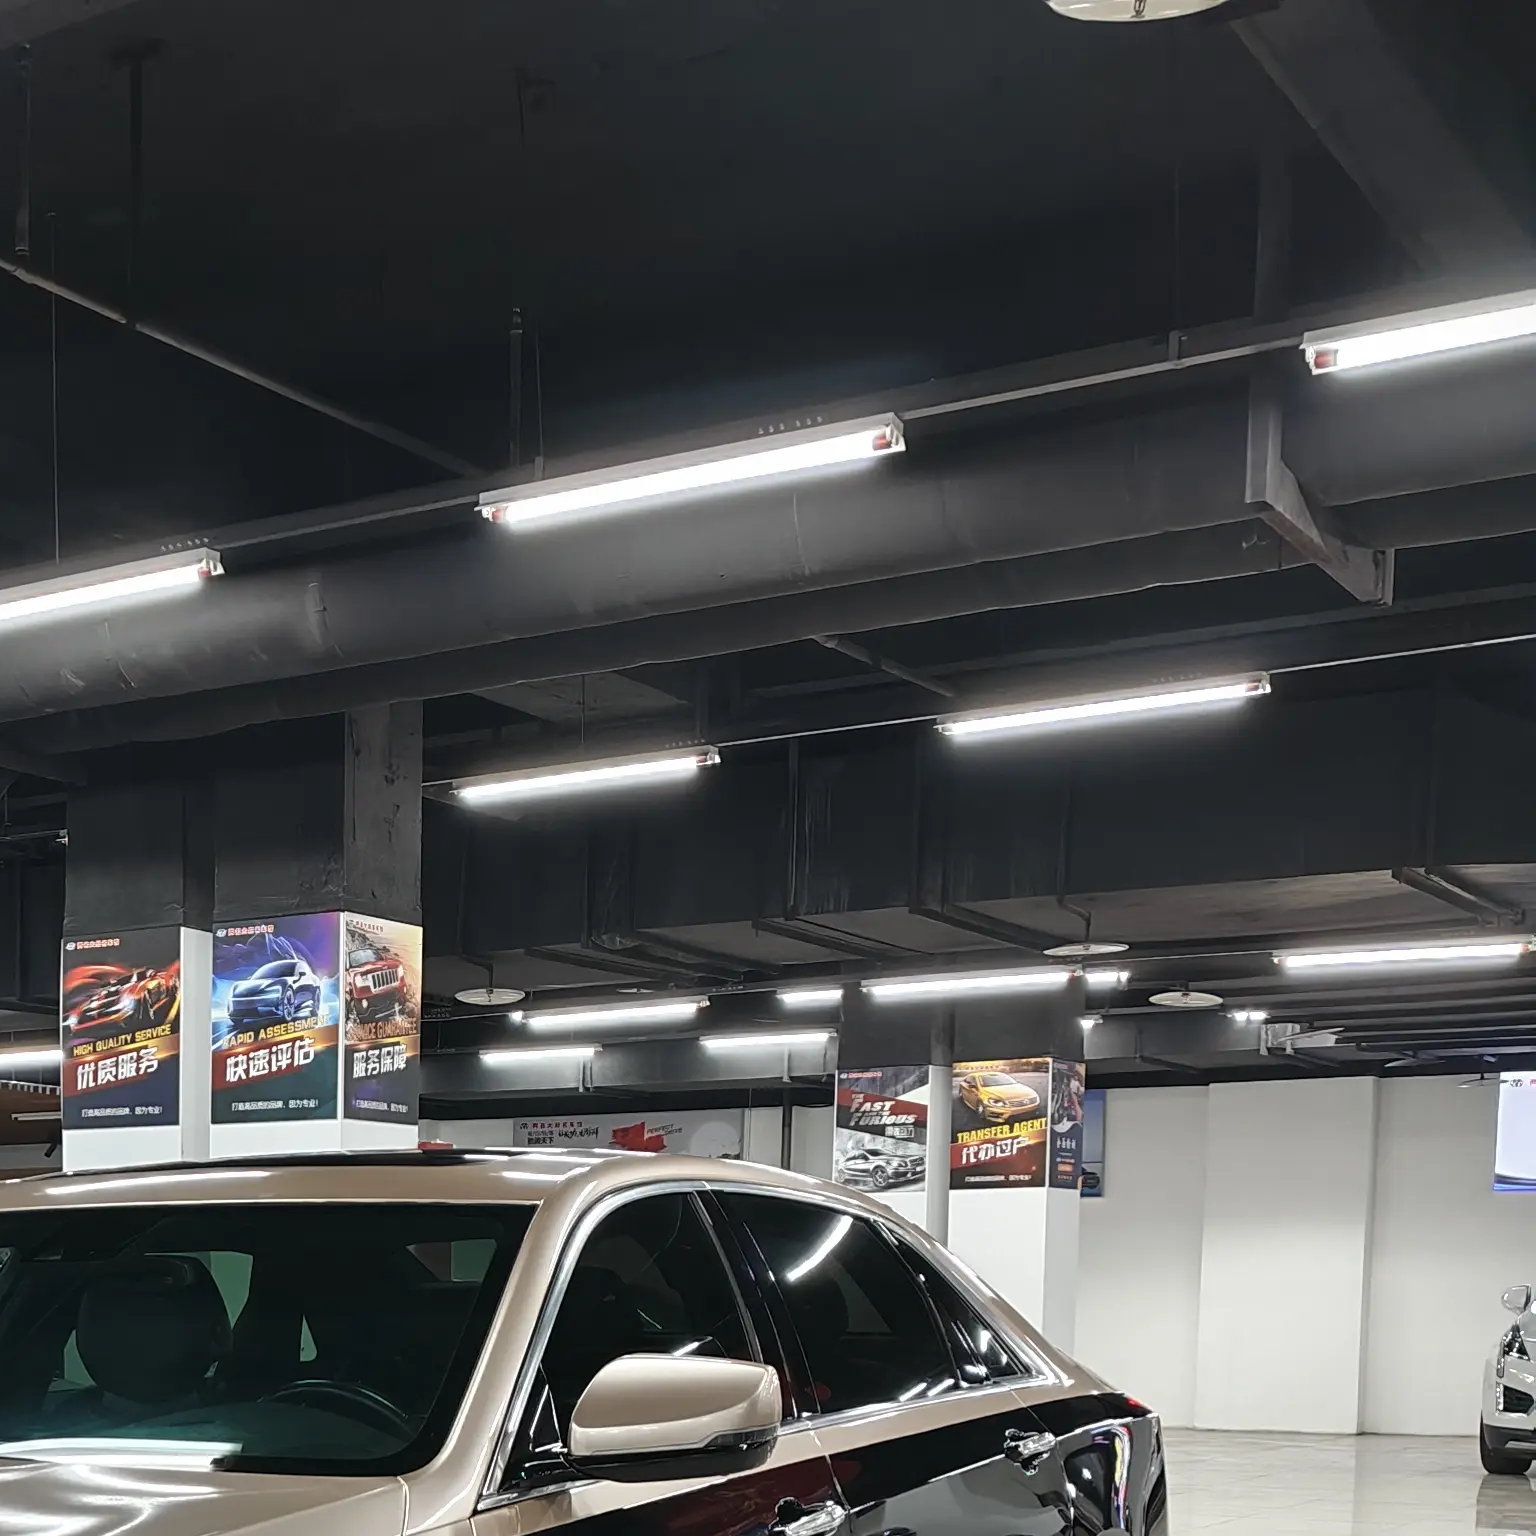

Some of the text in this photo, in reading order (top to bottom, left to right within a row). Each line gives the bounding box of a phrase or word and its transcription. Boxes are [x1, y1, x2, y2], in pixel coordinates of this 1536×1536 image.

[73, 1023, 172, 1057] HIGH QUALITY SERVICE
[222, 1014, 331, 1049] RAPID ASSESSMENT
[76, 1046, 159, 1091] 优质服务
[225, 1037, 315, 1083] 快速评估
[352, 1043, 408, 1079] 服务保障
[848, 1112, 918, 1127] FURIOUS
[849, 1098, 896, 1113] FAST
[957, 1117, 1047, 1143] TRANSFER AGENT
[961, 1136, 1030, 1165] 代办过户
